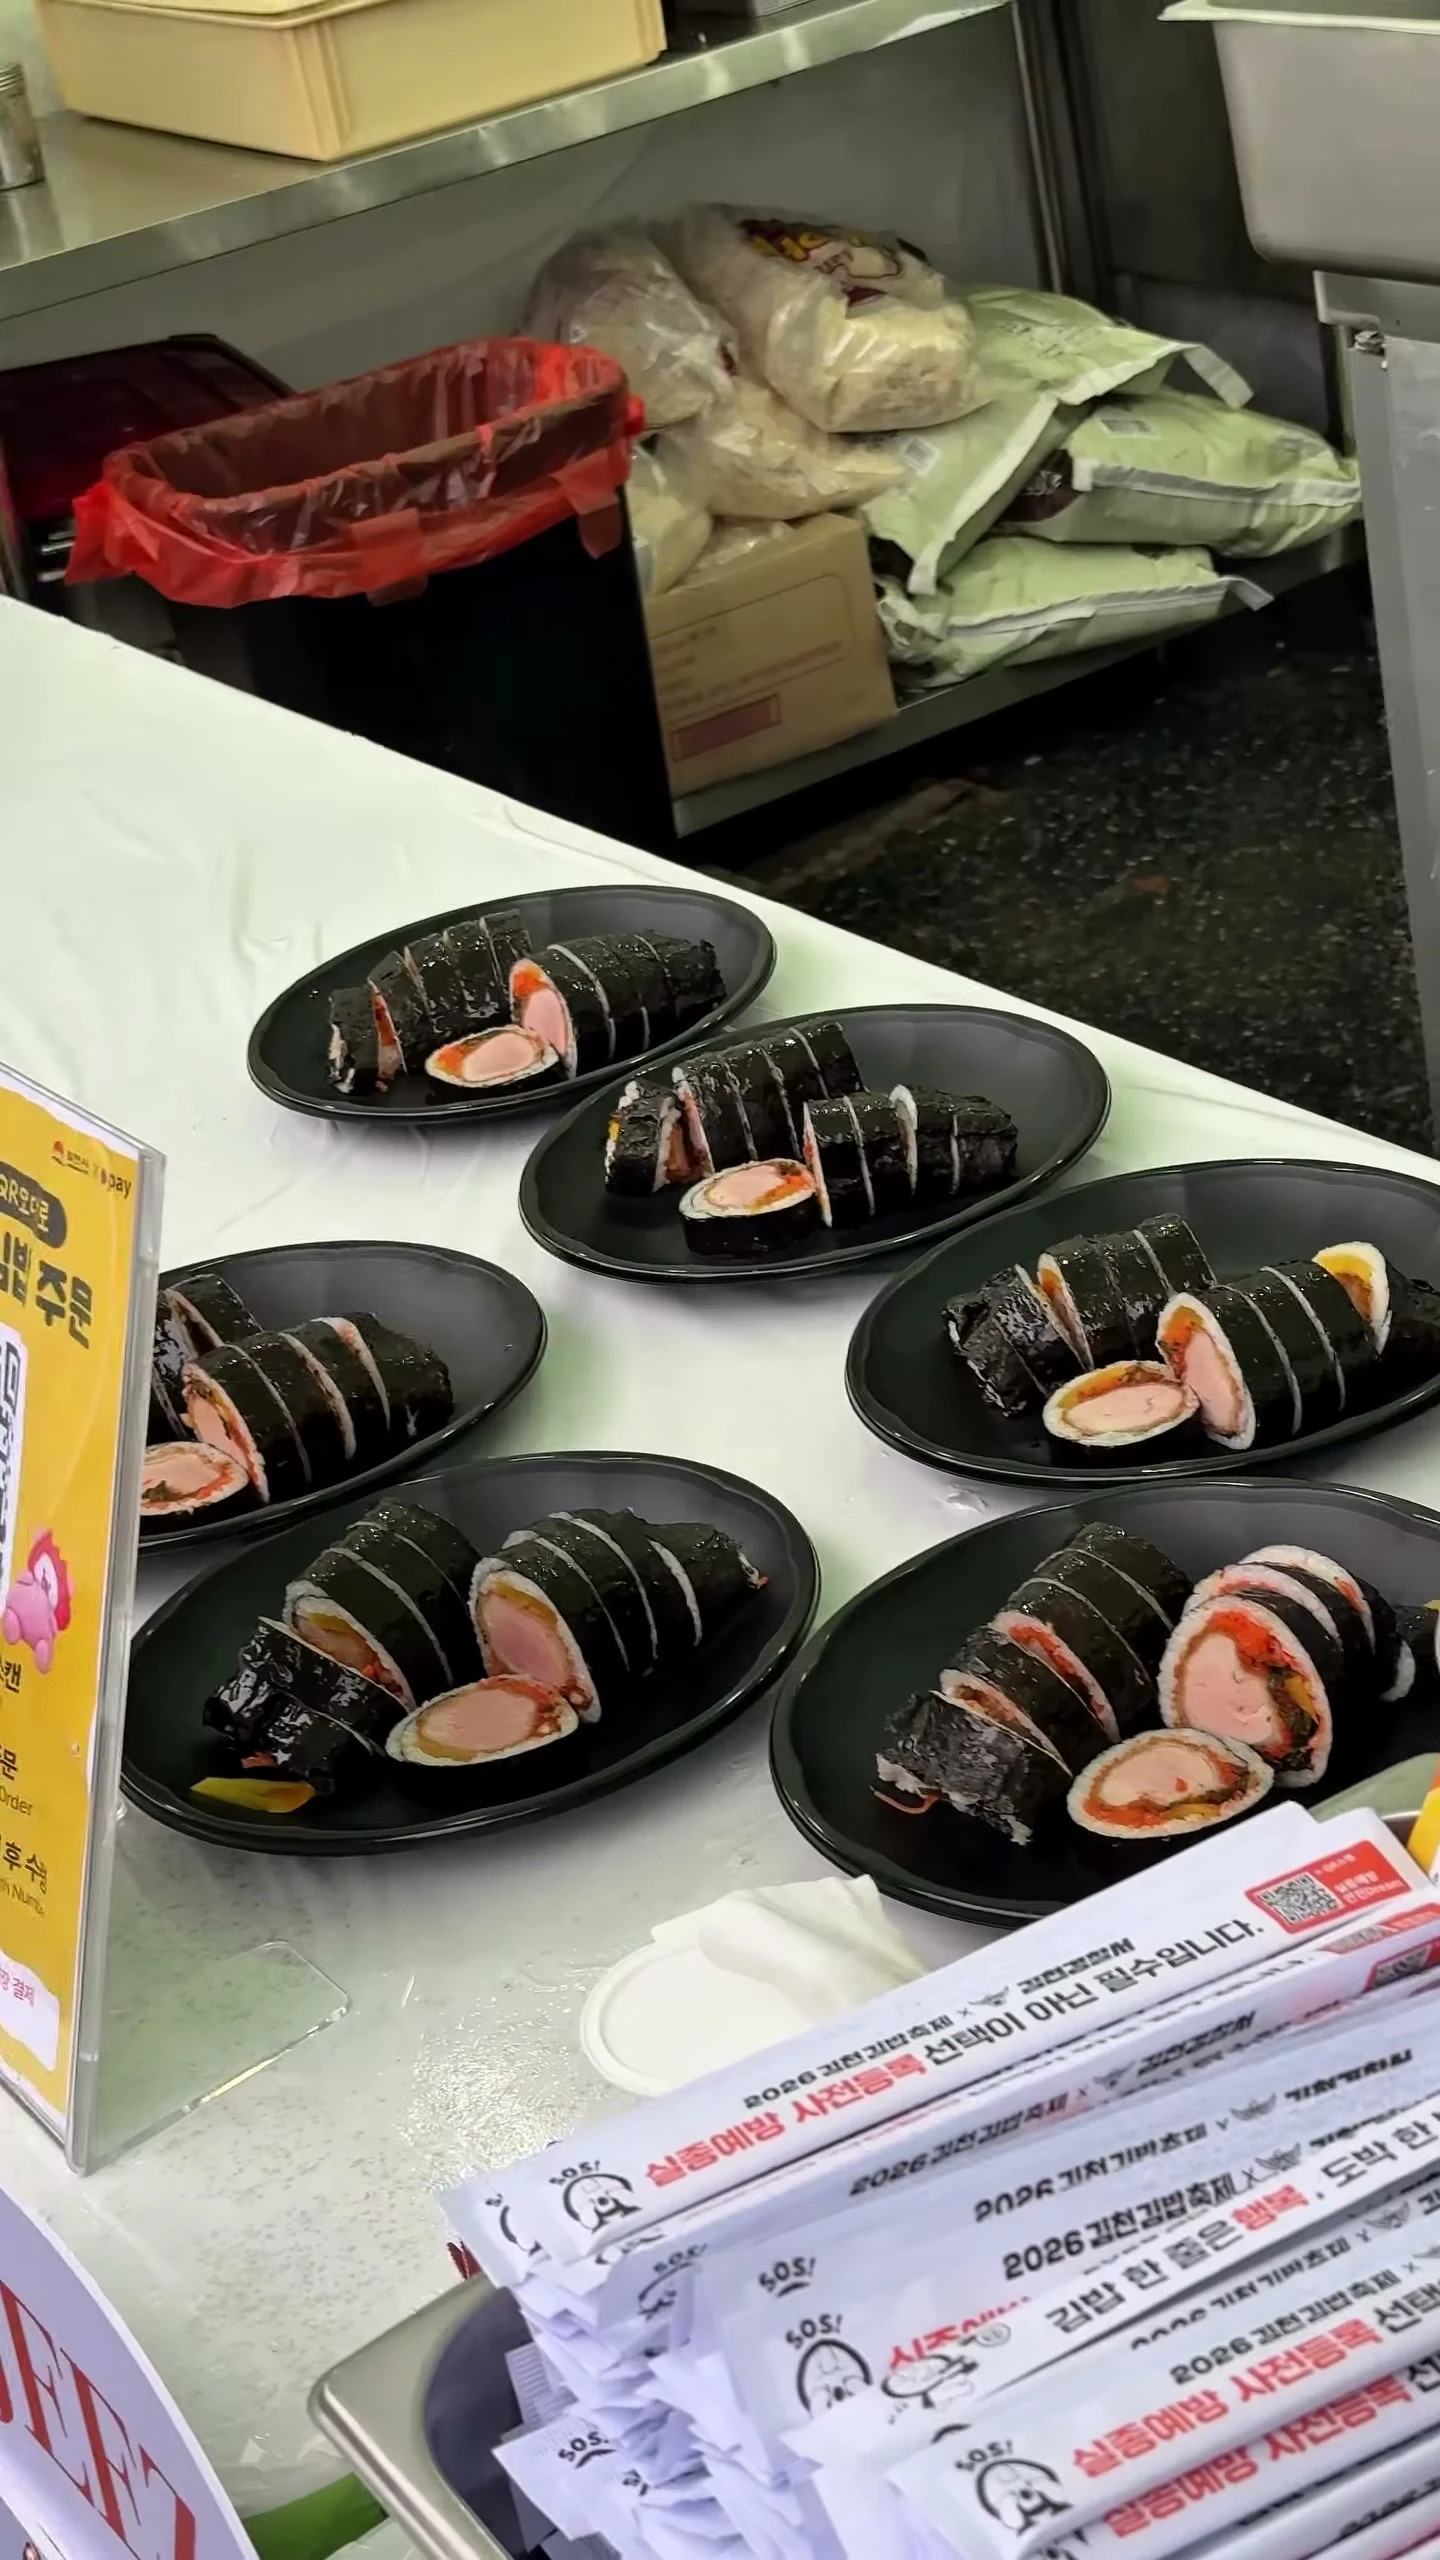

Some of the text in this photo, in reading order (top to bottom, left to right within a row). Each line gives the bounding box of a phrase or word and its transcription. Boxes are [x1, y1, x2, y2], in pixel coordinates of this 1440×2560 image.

[36, 1259, 93, 1350] 주문
[646, 1918, 1265, 2187] 실종예방 사전등록 선택이 아닌 필수입니다.
[743, 2071, 817, 2109] 2026
[849, 2152, 927, 2197] 2026
[1045, 2280, 1127, 2334] 김밥
[1121, 2257, 1169, 2291] 한
[1321, 2139, 1399, 2188] 도박
[1391, 2121, 1440, 2151] 한
[758, 2256, 816, 2293] SOS!
[1002, 2233, 1085, 2281] 2026
[785, 2313, 844, 2350] SOS!
[1169, 2335, 1255, 2386] 2026
[1073, 2388, 1230, 2479] 실종예방
[1230, 2317, 1384, 2402] 사전등록
[1103, 2445, 1259, 2539] 실종예방
[1262, 2373, 1414, 2460] 사전등록
